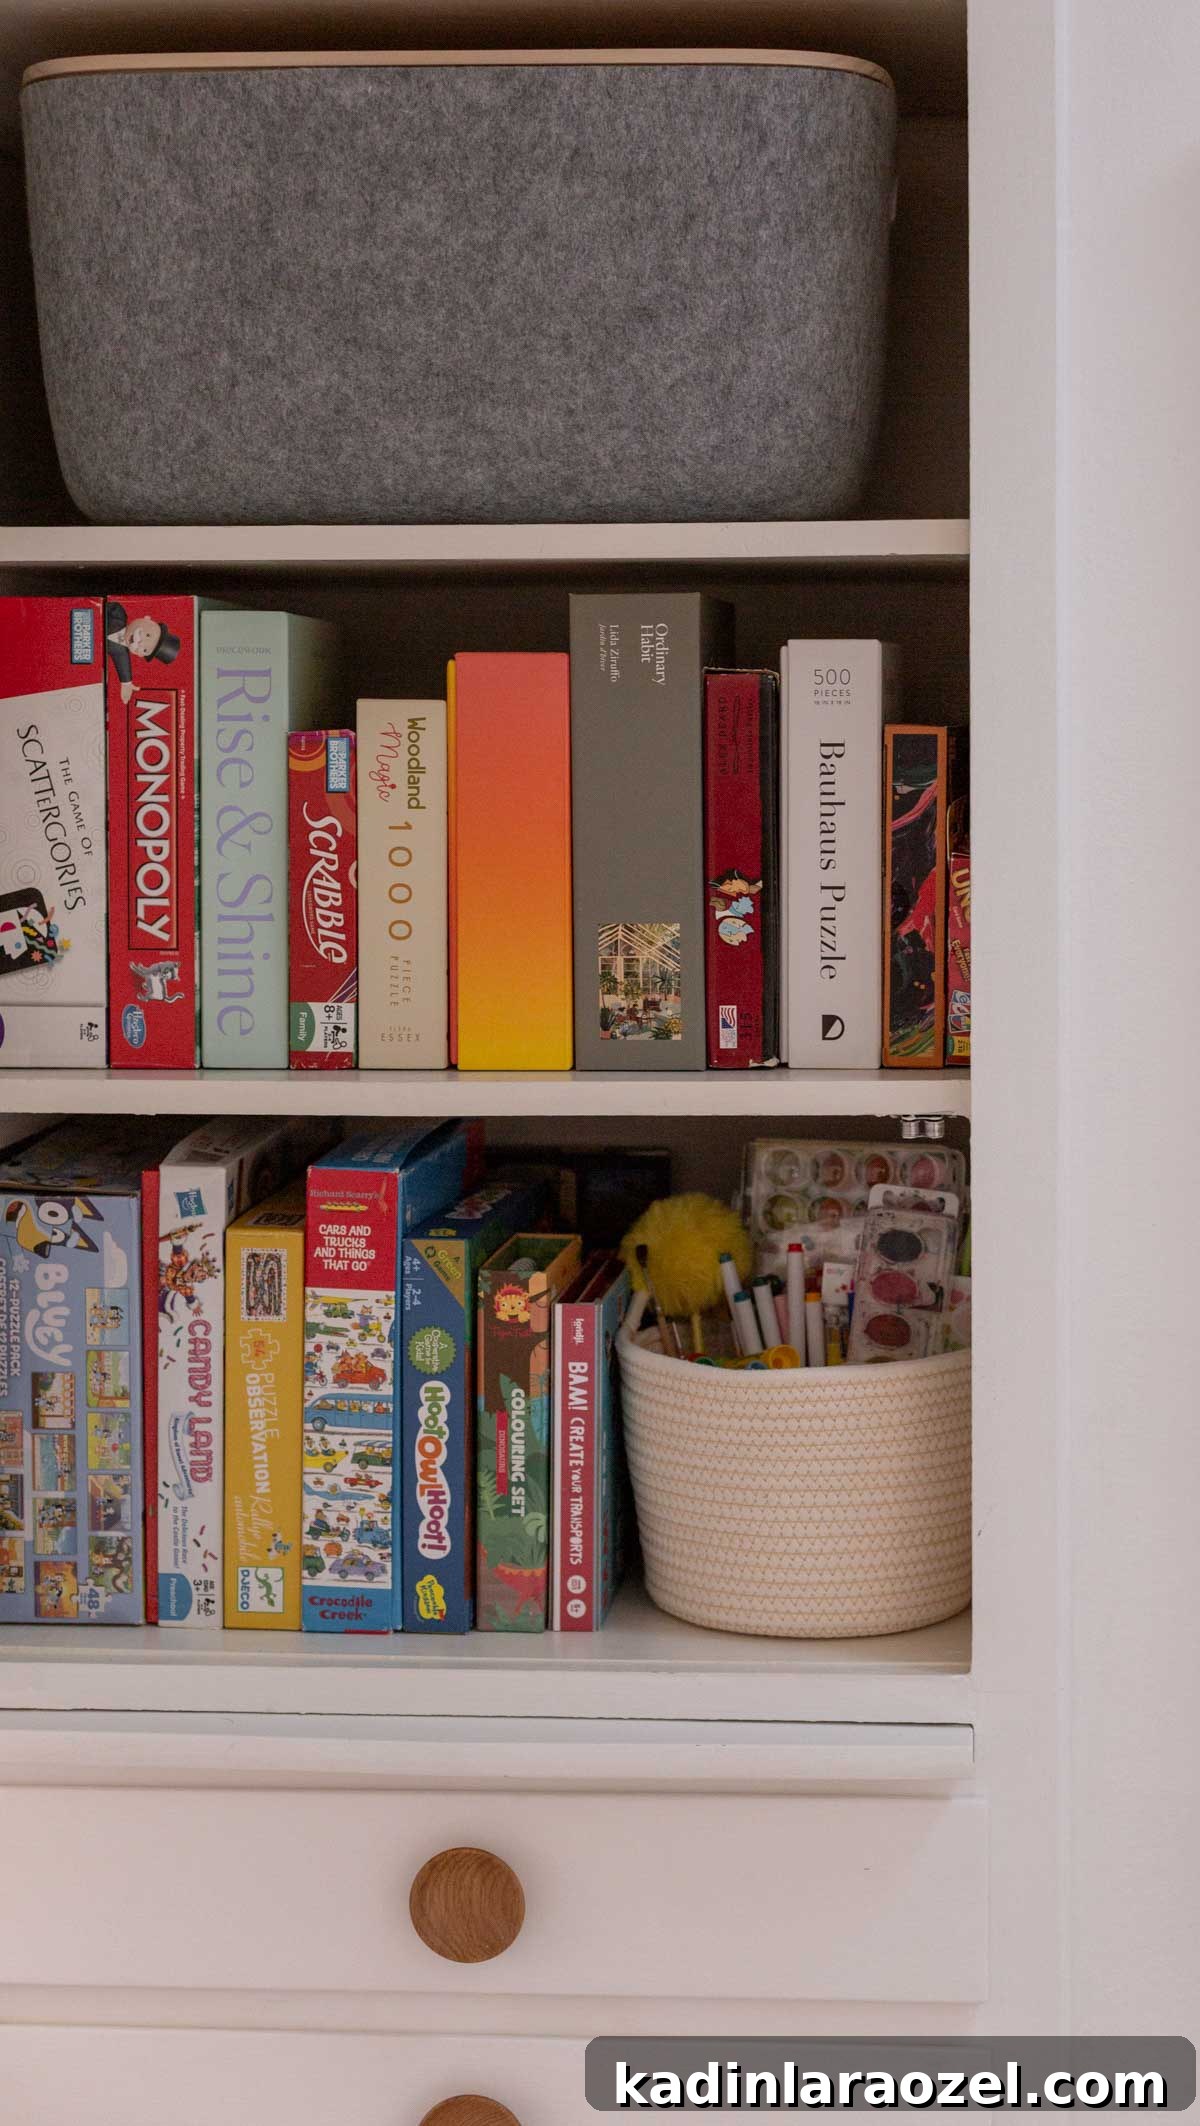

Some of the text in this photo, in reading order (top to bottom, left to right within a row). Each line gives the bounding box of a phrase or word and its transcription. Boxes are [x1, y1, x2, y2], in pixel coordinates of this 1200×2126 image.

[73, 611, 82, 661] BROTHERS
[80, 624, 91, 661] PARKER
[609, 624, 620, 683] Lida Ziruffo
[640, 624, 654, 663] Habit
[651, 623, 669, 686] Ordinary
[814, 668, 851, 686] 500
[814, 689, 851, 697] PIECES
[329, 740, 338, 789] BROTHERS
[336, 753, 347, 789] PARKER
[368, 722, 401, 802] Magic
[406, 717, 426, 810] Woodland
[16, 725, 87, 912] SCATTERGORIES
[59, 757, 95, 858] THE GAME OF
[135, 700, 171, 942] MONOPOLY
[216, 666, 276, 1037] Rise & Shine
[818, 738, 847, 981] Bauhaus Puzzle
[389, 956, 400, 1009] PUZZLE
[402, 960, 412, 1005] PIECE
[297, 1012, 307, 1041] Family
[323, 1005, 336, 1021] 8+
[380, 1033, 421, 1042] ESSEX
[318, 1224, 371, 1237] CARS AND
[323, 1236, 366, 1248] TRUCKS
[313, 1247, 376, 1260] AND THINGS
[322, 1259, 368, 1272] THAT GO
[404, 1255, 412, 1274] Ages
[412, 1257, 421, 1272] 4+
[433, 1259, 451, 1282] Game
[437, 1248, 462, 1280] Green
[404, 1283, 412, 1311] Players
[412, 1288, 421, 1306] 2-4
[10, 1278, 20, 1377] 12-PUZZLE PACK
[424, 1334, 432, 1357] Game
[252, 1340, 265, 1358] 54
[440, 1342, 448, 1350] A
[186, 1319, 213, 1485] CANDY LAND
[567, 1361, 588, 1411] BAM!
[259, 1372, 280, 1440] PUZZLE
[245, 1373, 271, 1494] OBSERVATION
[568, 1417, 585, 1467] CREATE
[498, 1430, 506, 1474] DINOSAURS
[509, 1388, 526, 1517] COLOURING SET
[571, 1469, 583, 1493] YOUR
[172, 1505, 178, 1514] to
[568, 1495, 584, 1565] TRANSPORTS
[88, 1588, 100, 1610] 48
[193, 1579, 202, 1593] 3+
[240, 1569, 250, 1611] DJECO
[308, 1594, 374, 1610] Crocodile
[319, 1609, 363, 1622] Creek
